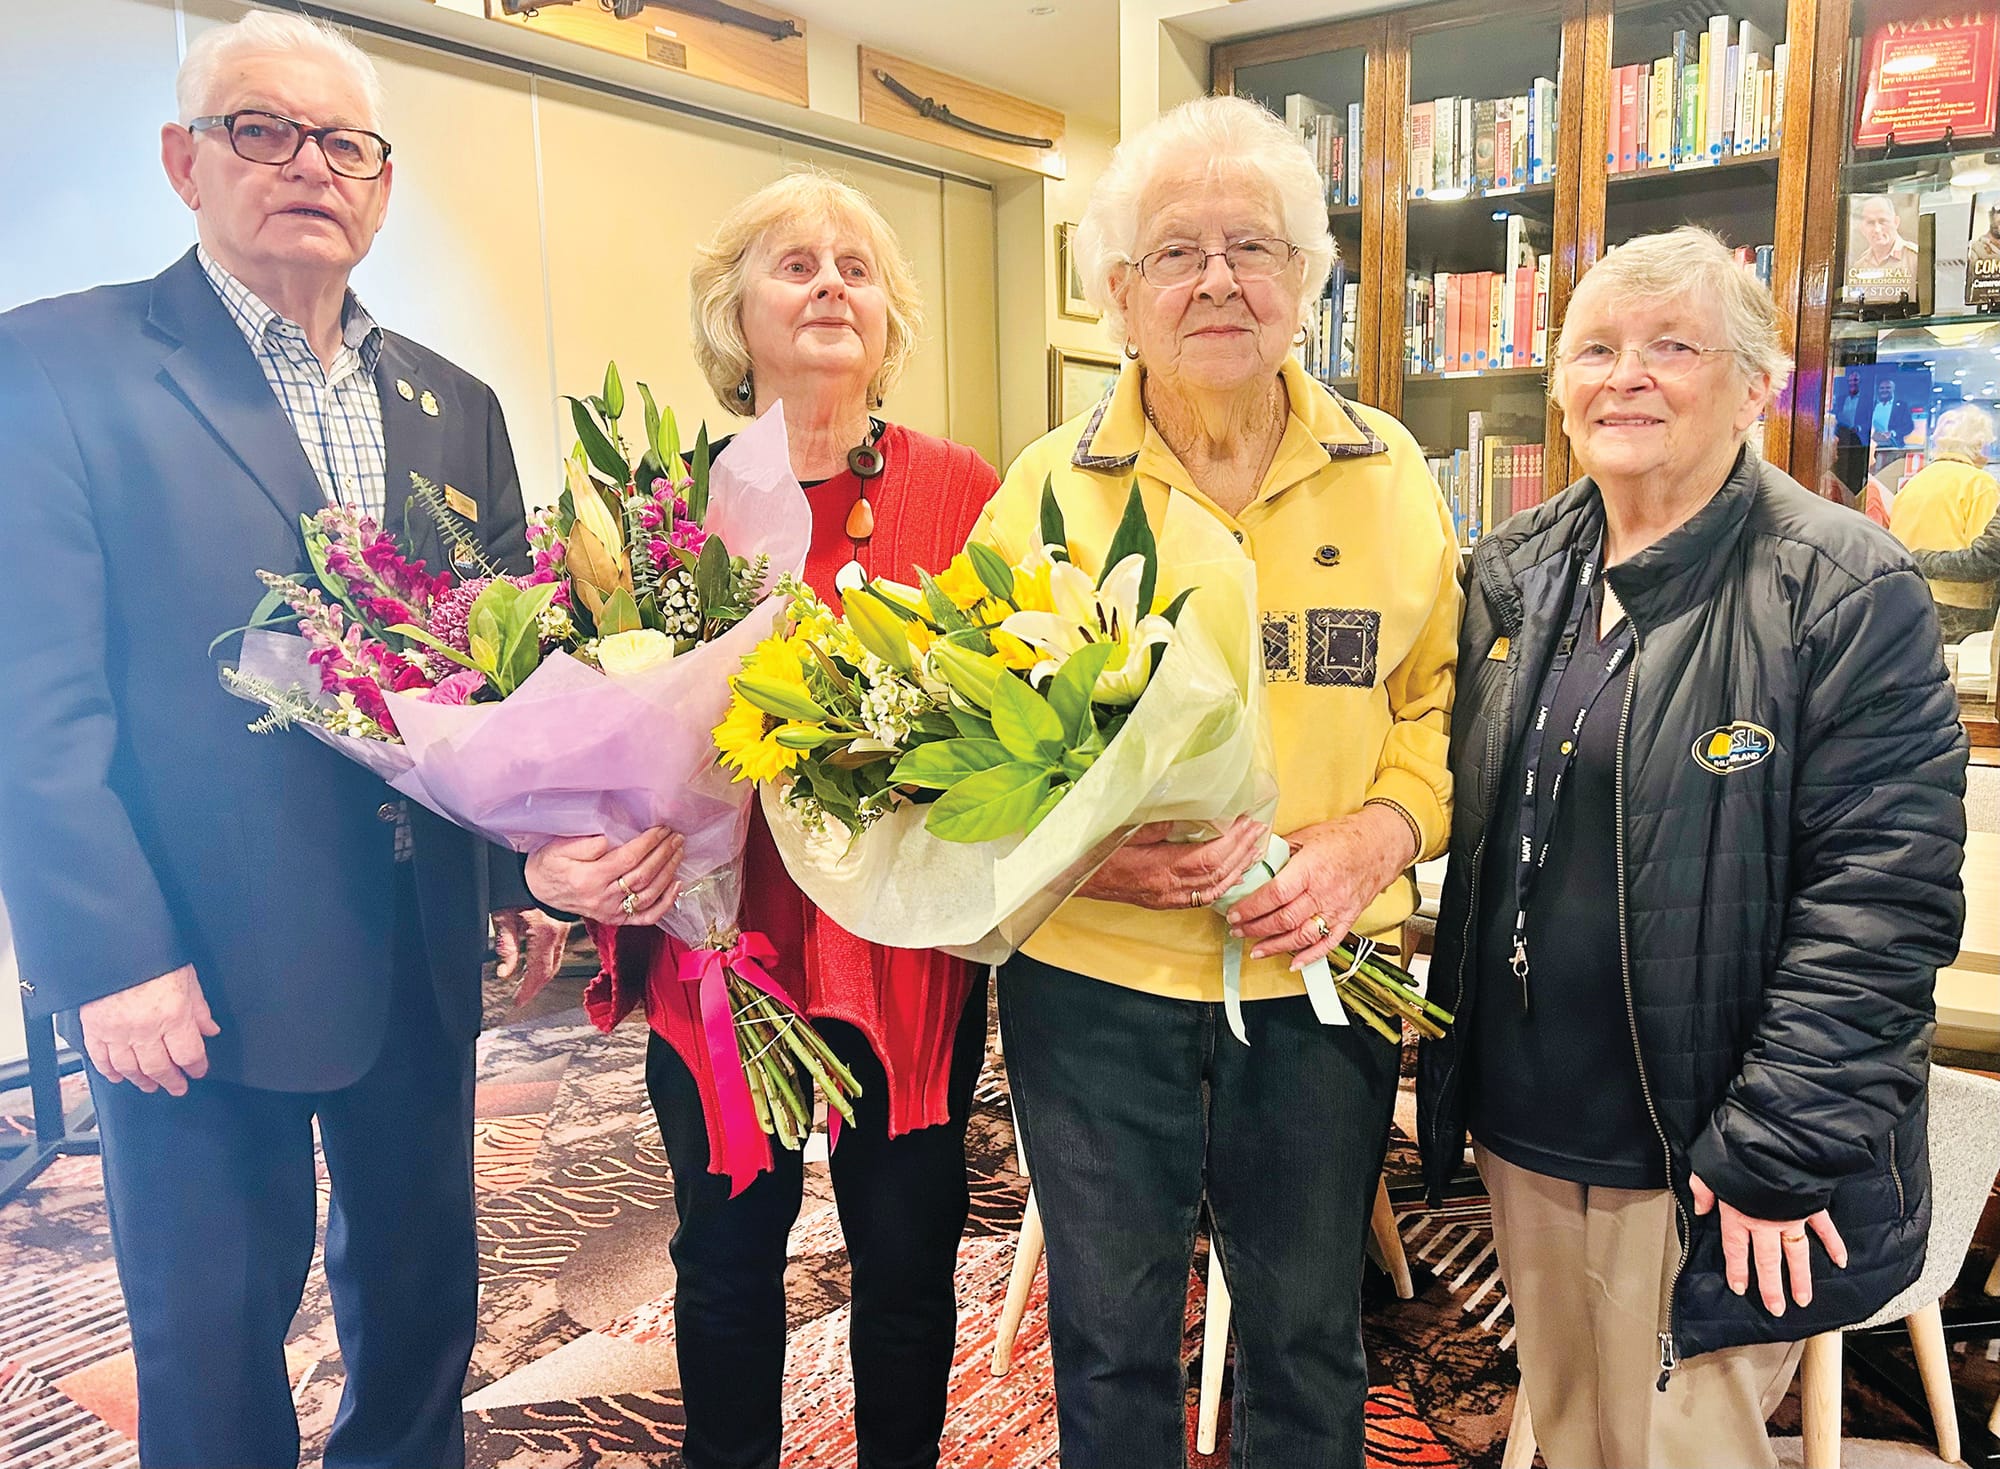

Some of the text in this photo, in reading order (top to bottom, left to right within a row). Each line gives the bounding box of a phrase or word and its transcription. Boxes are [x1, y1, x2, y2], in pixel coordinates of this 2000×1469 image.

[1656, 66, 1664, 106] ANZACS
[1421, 114, 1431, 148] DESCENT
[1579, 562, 1593, 585] NAVY
[1606, 648, 1624, 673] NAVY
[1535, 706, 1549, 730] NAVY
[1525, 770, 1535, 795] NAVY
[1521, 835, 1532, 862] NAVY
